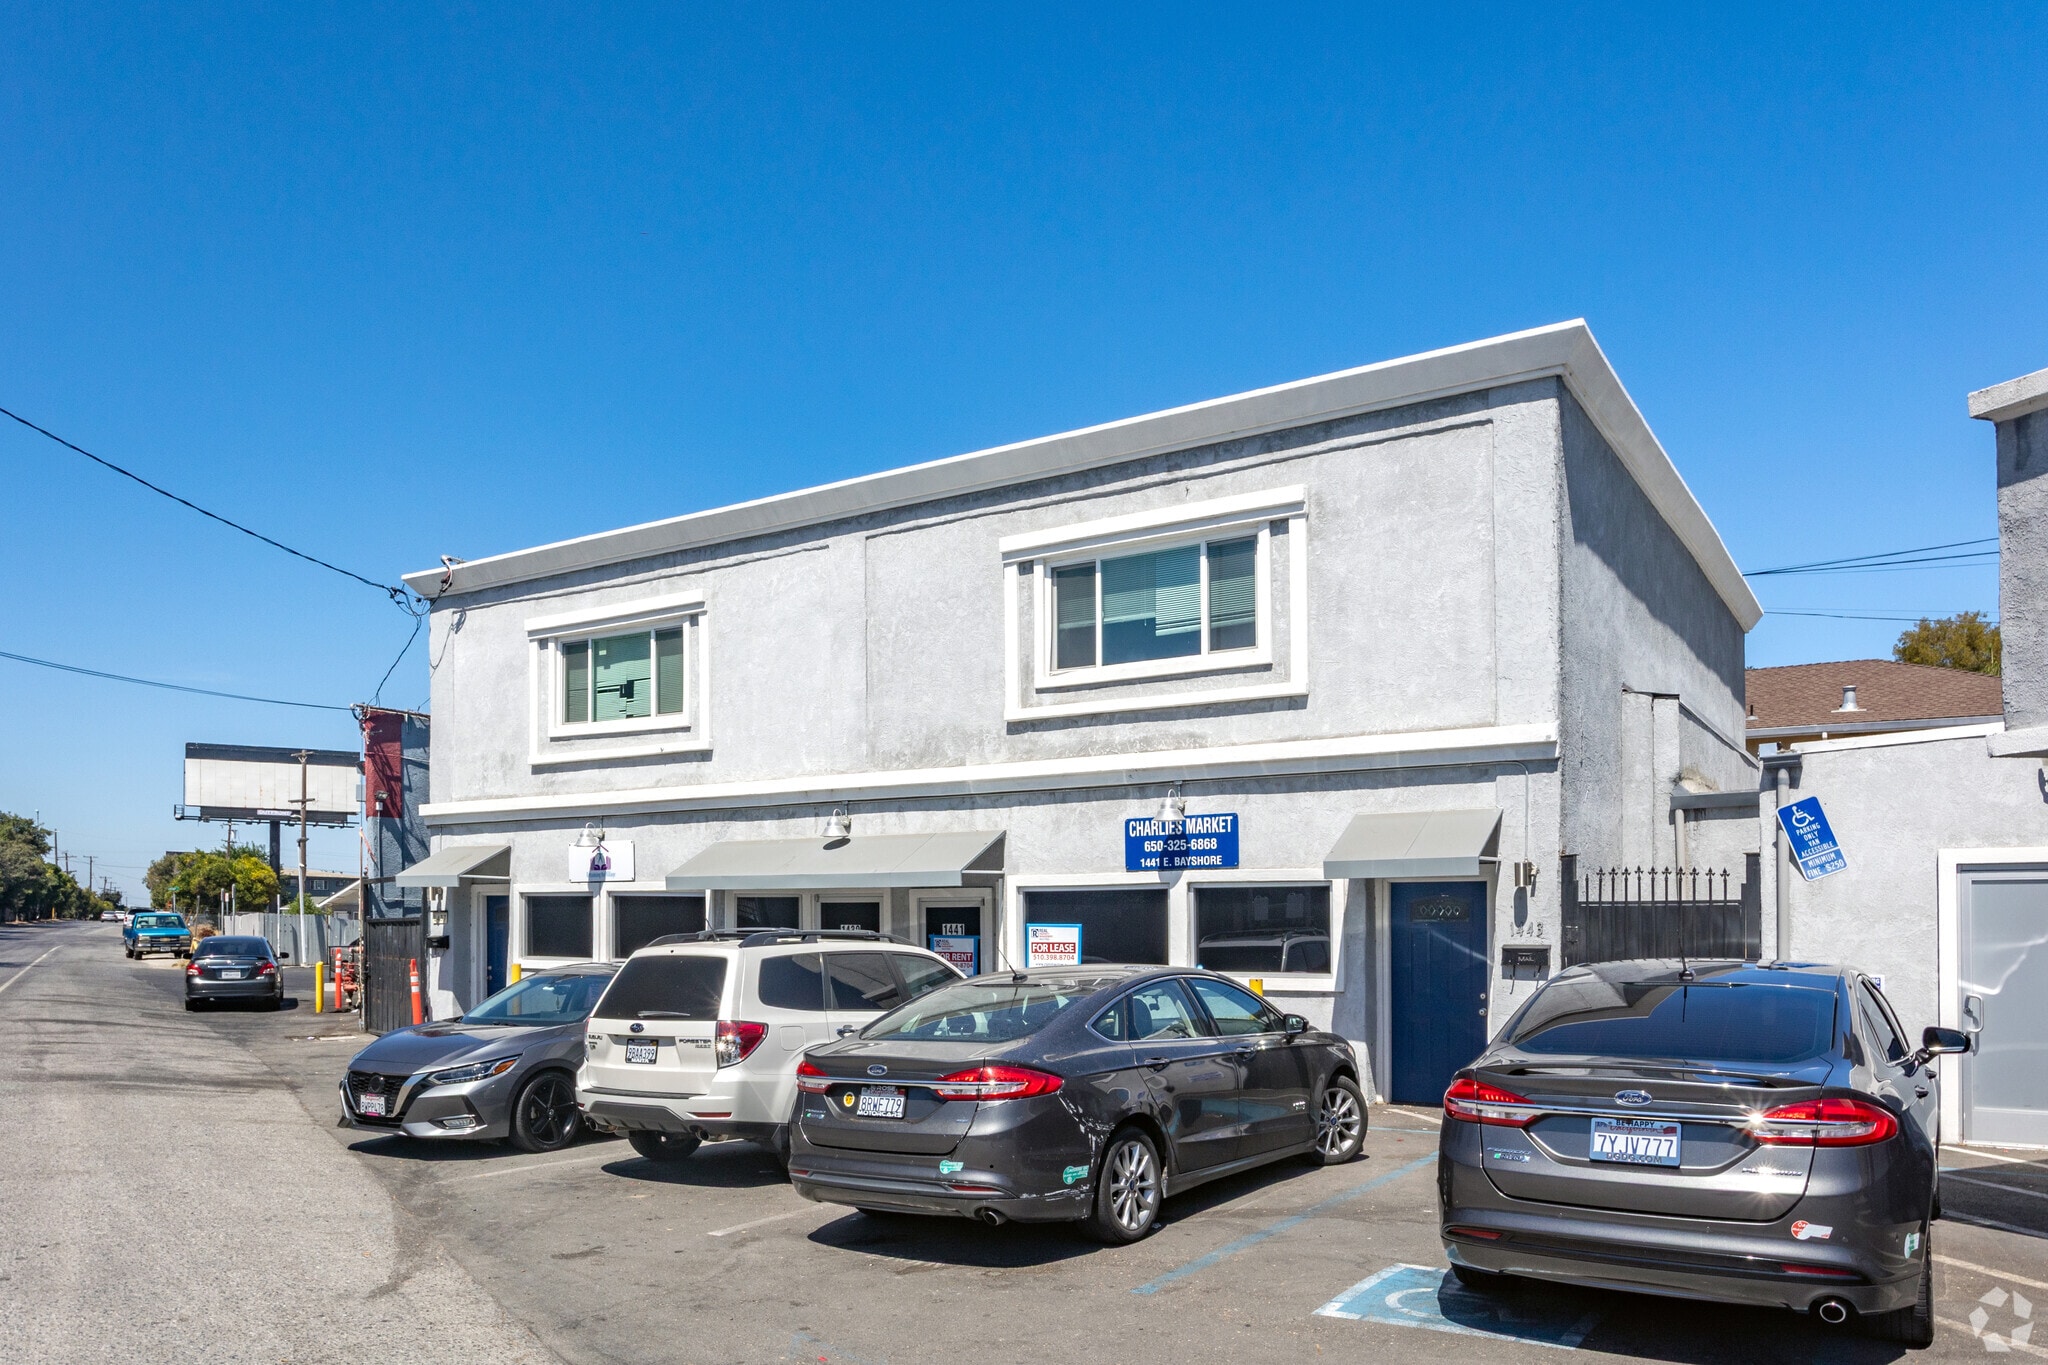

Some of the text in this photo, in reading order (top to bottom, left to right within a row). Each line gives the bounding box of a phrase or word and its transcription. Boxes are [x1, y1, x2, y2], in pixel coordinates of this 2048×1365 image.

[1129, 815, 1233, 837] CHARLIES MARKET
[1795, 822, 1821, 836] PARKING
[1803, 831, 1819, 841] ONLY
[1807, 838, 1820, 847] VAN
[1144, 838, 1217, 852] 650-325-6868
[1801, 841, 1834, 858] ACCESSIBLE
[1140, 855, 1222, 867] 1441 E. BAYSHORE
[1807, 852, 1837, 868] MINIMUM
[1806, 860, 1845, 878] FINE $250
[943, 924, 965, 936] 1441
[1510, 921, 1544, 938] 1443
[1032, 943, 1075, 953] FOR LEASE
[951, 953, 972, 961] RENT
[628, 1047, 656, 1060] 9BAA399
[861, 1096, 903, 1113] 8RWF779
[857, 1109, 903, 1118] MOTORCARS
[1629, 1120, 1655, 1128] HAPPY
[1597, 1134, 1674, 1157] 7YJV777
[1606, 1153, 1662, 1164] DGDG.COM
